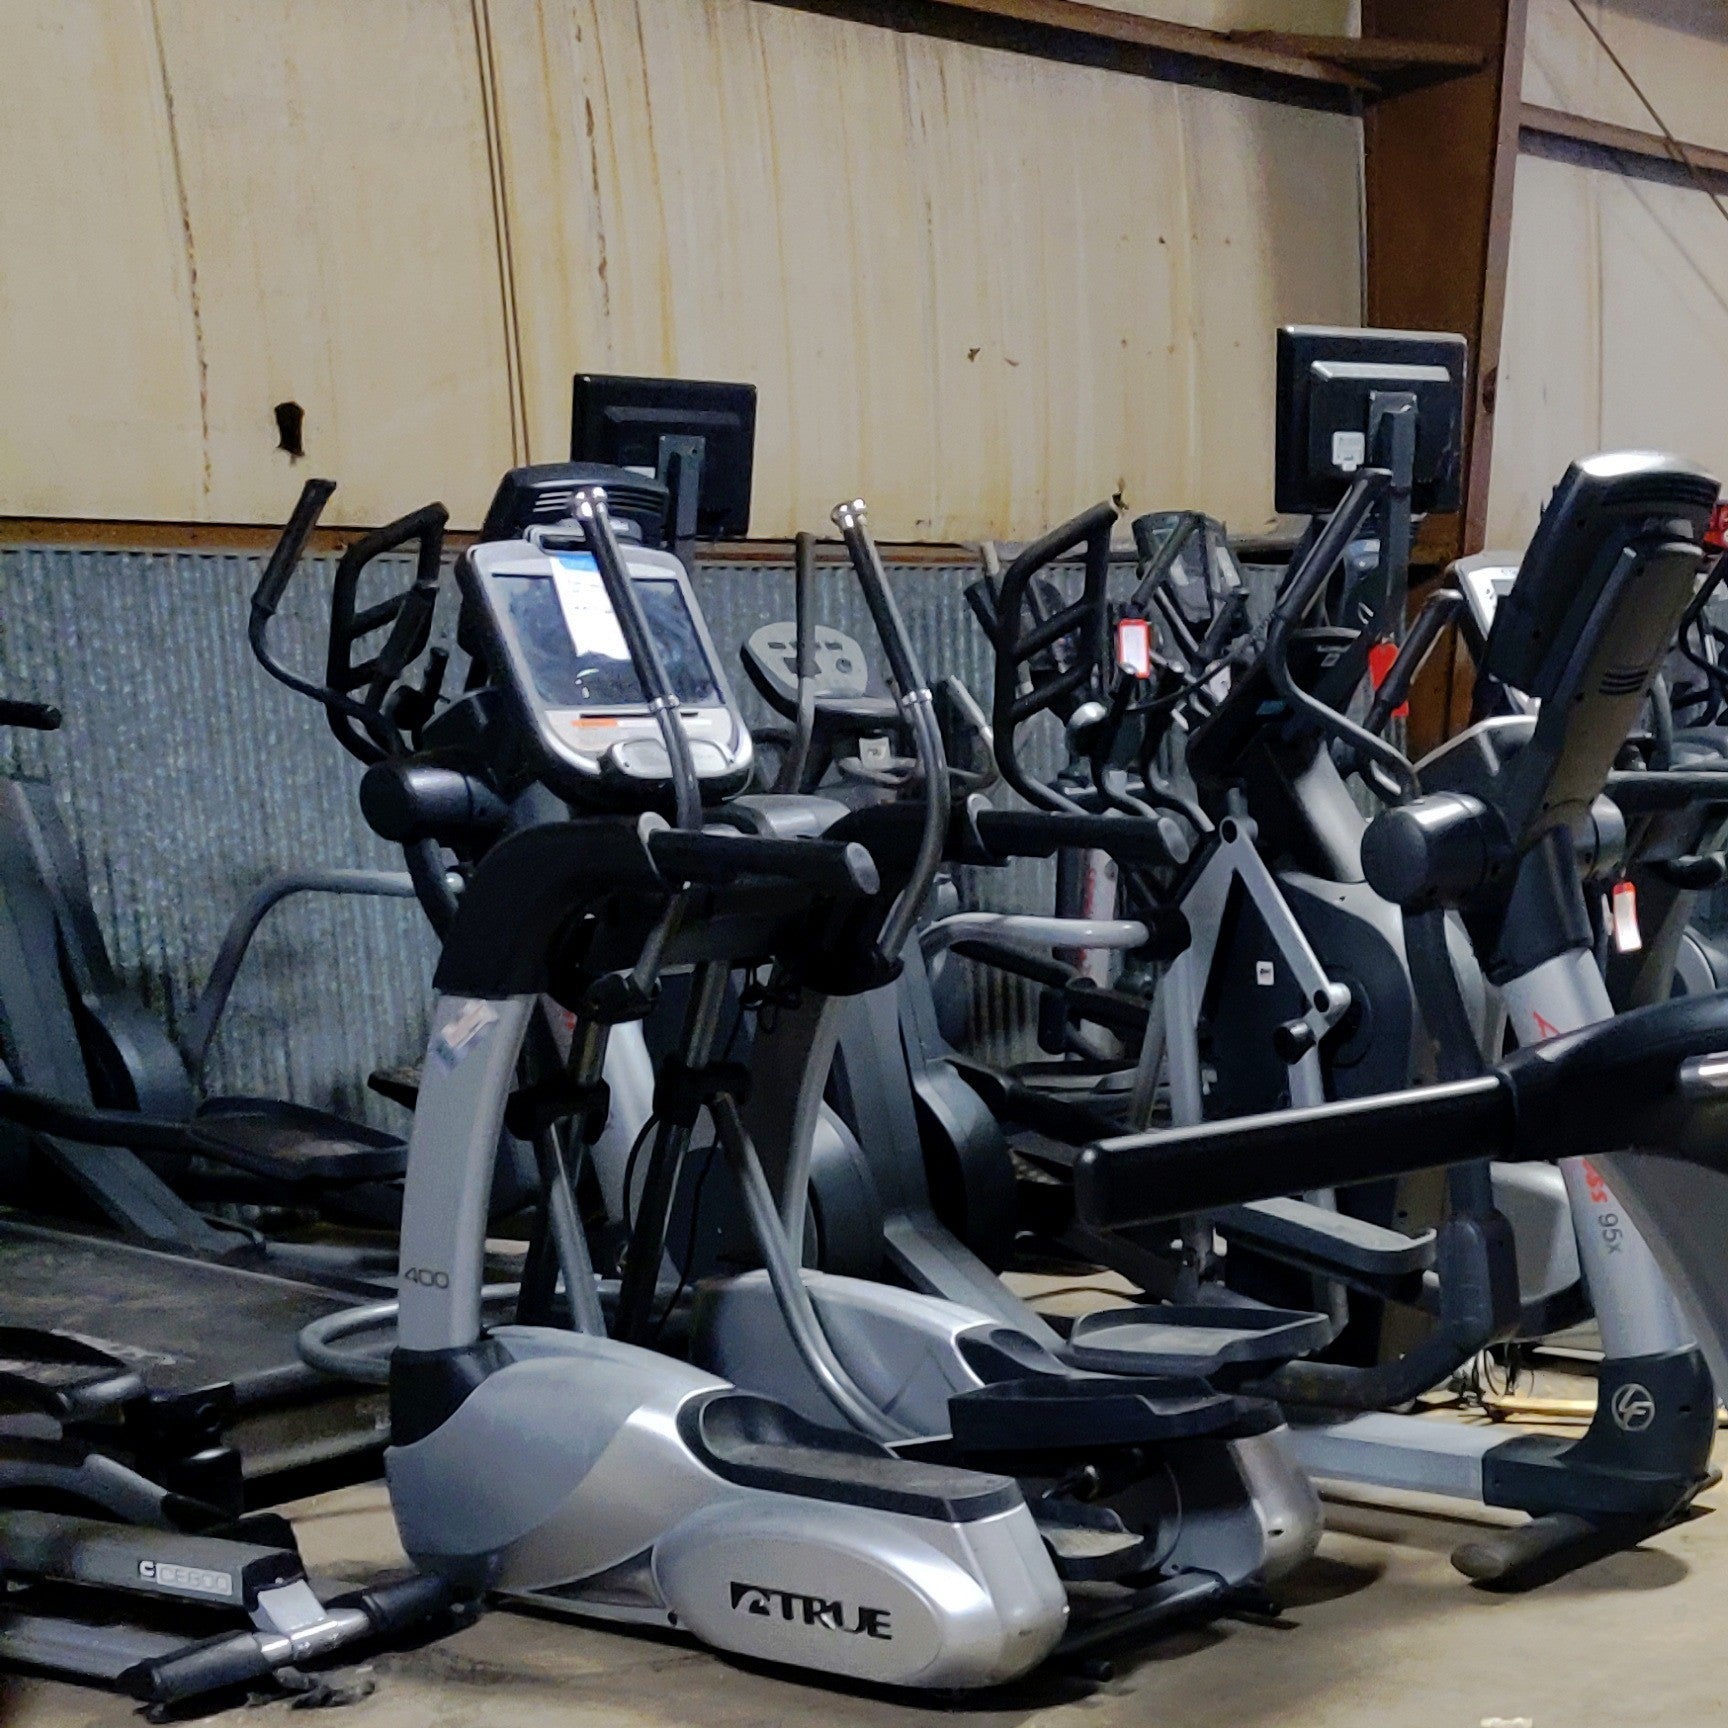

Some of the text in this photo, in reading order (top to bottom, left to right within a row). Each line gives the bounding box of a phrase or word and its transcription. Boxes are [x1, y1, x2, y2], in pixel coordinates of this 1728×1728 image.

[1597, 1211, 1624, 1255] 95x
[404, 1266, 450, 1290] 400
[768, 1590, 892, 1640] TRUE
